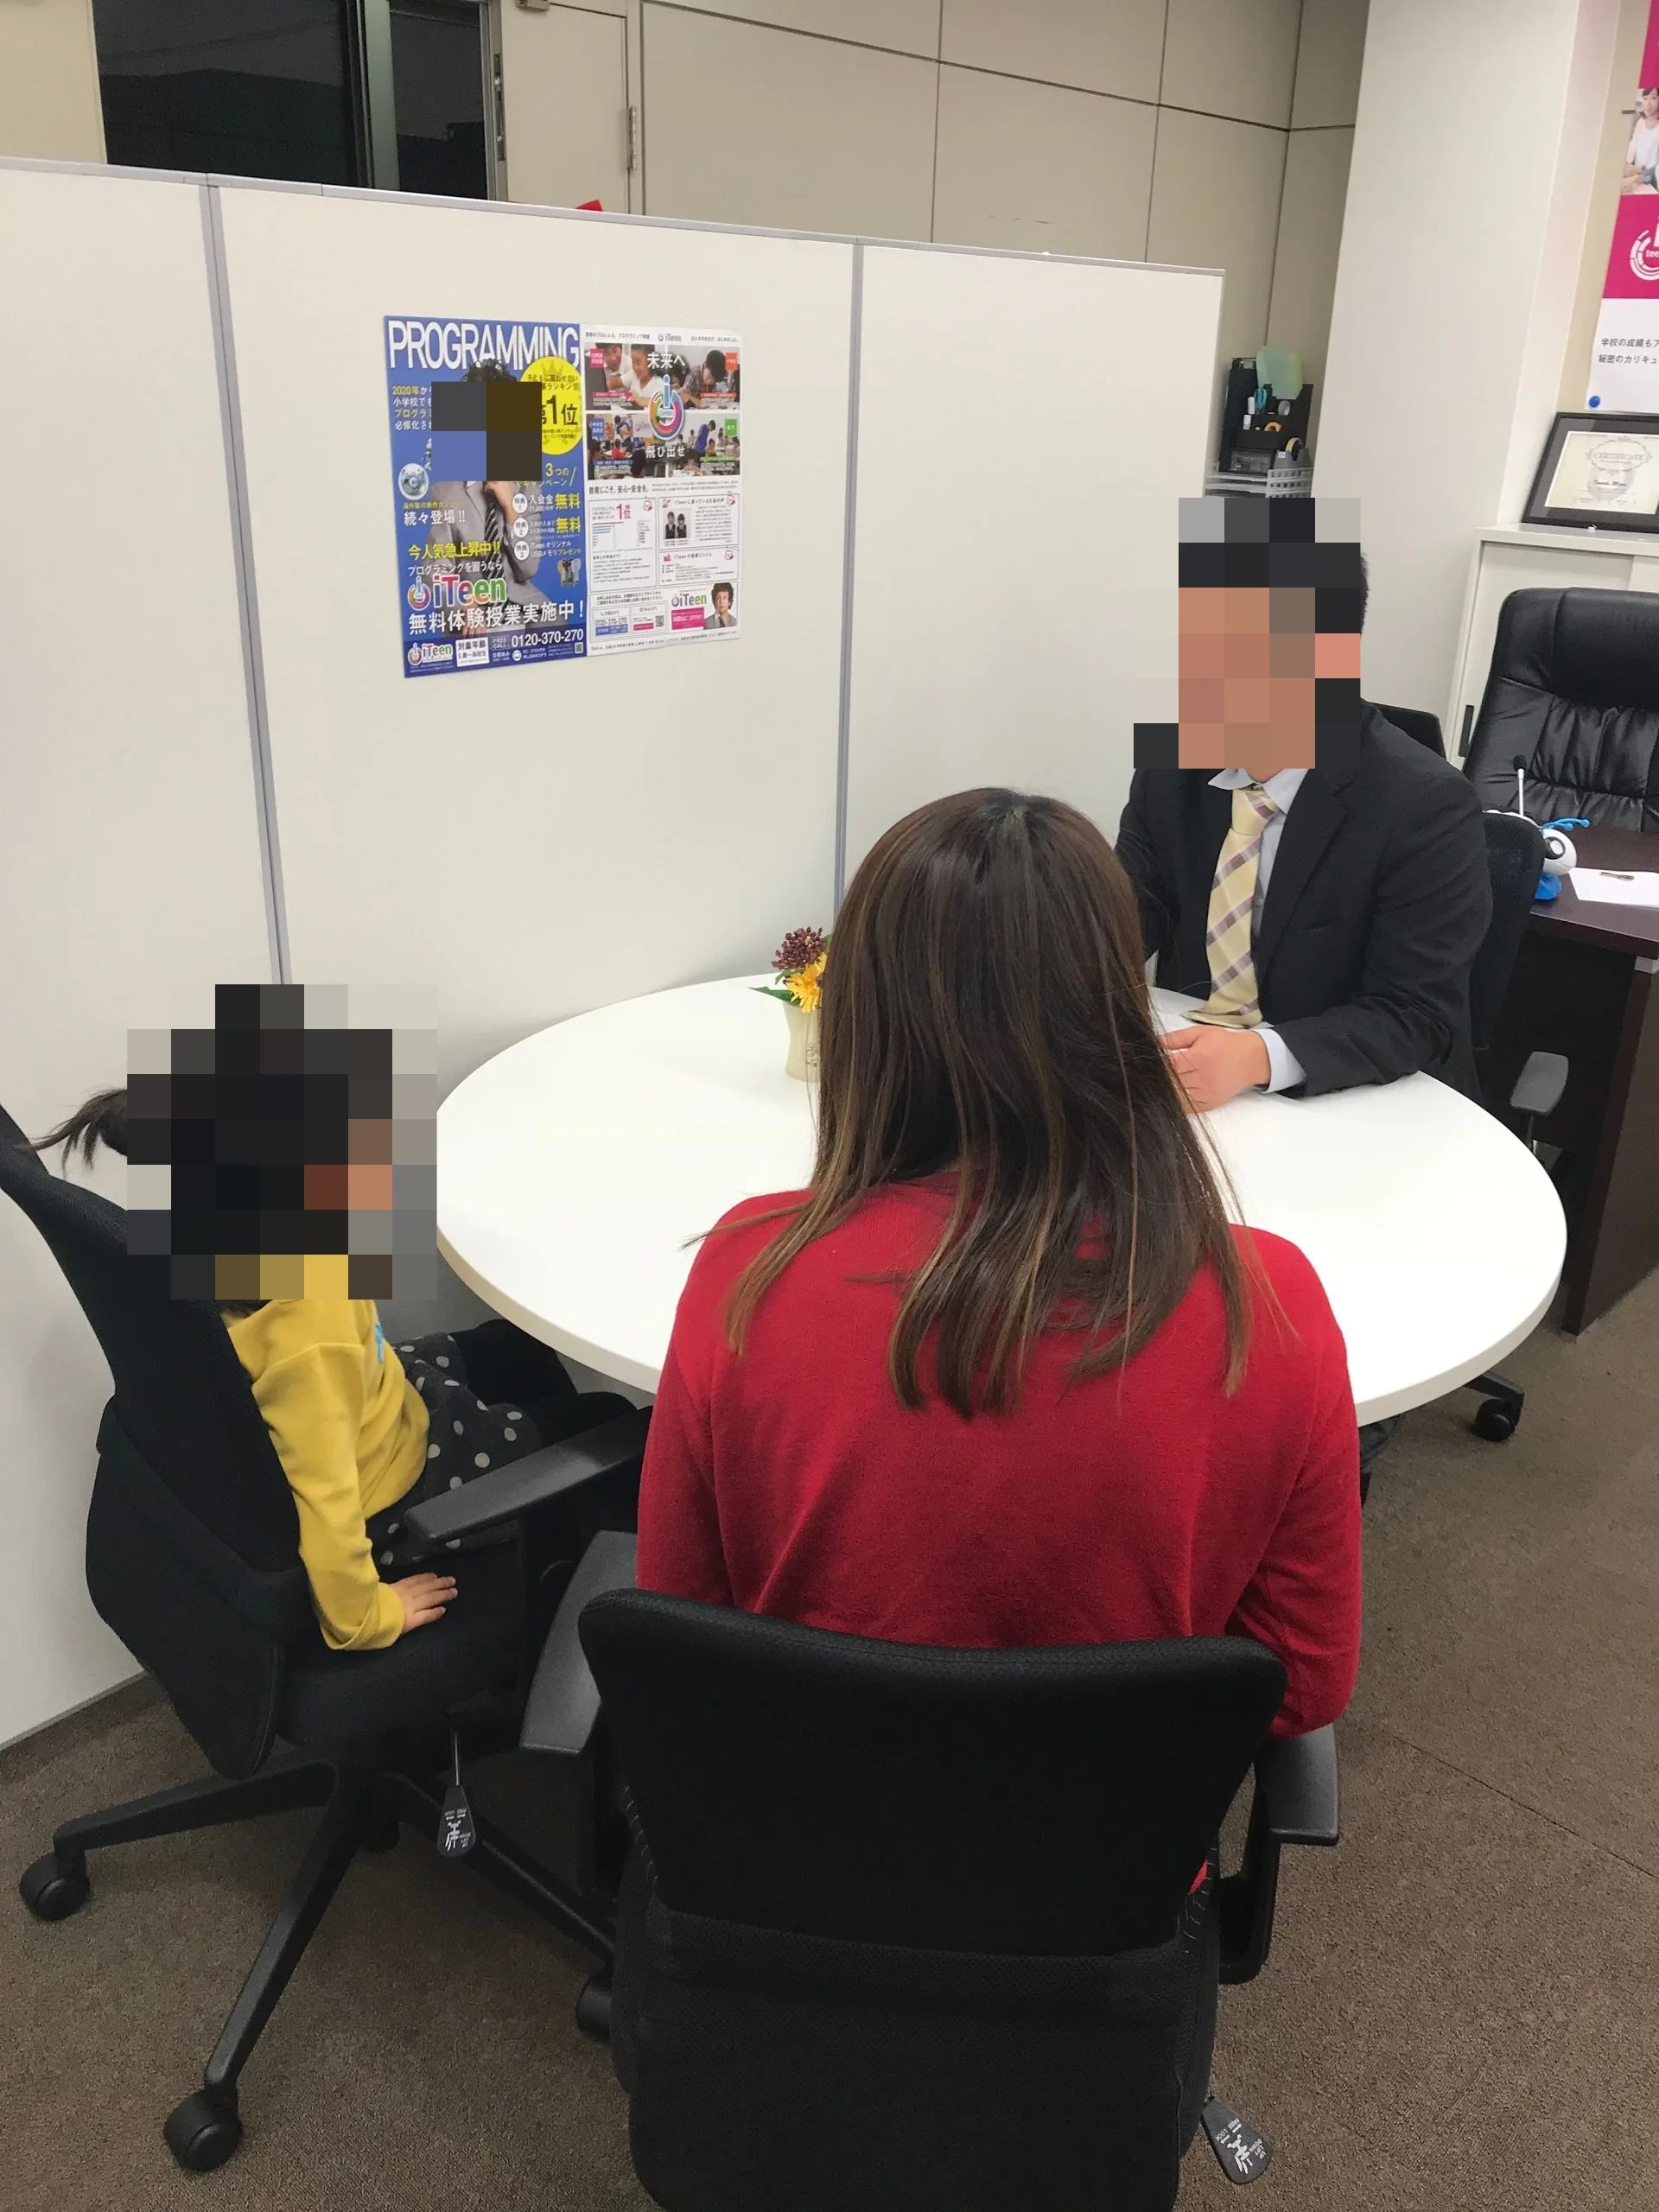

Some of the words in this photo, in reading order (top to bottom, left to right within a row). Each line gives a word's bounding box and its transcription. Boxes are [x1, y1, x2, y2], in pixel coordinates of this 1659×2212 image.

[388, 320, 580, 371] PROGRAMMING
[647, 352, 686, 370] 未来へ
[645, 445, 686, 459] 飛び出せ
[529, 493, 554, 505] 入会金
[555, 493, 581, 510] 無料
[556, 516, 582, 534] 無料
[408, 541, 500, 561] 今人気急上昇中!!
[408, 560, 503, 577] プログラミングを習うなら
[432, 574, 507, 608] iTeen
[679, 593, 707, 607] iTeen
[409, 600, 583, 636] 無料体験授業実施中!
[511, 628, 584, 648] 0120-370-270
[422, 643, 452, 658] iTeen
